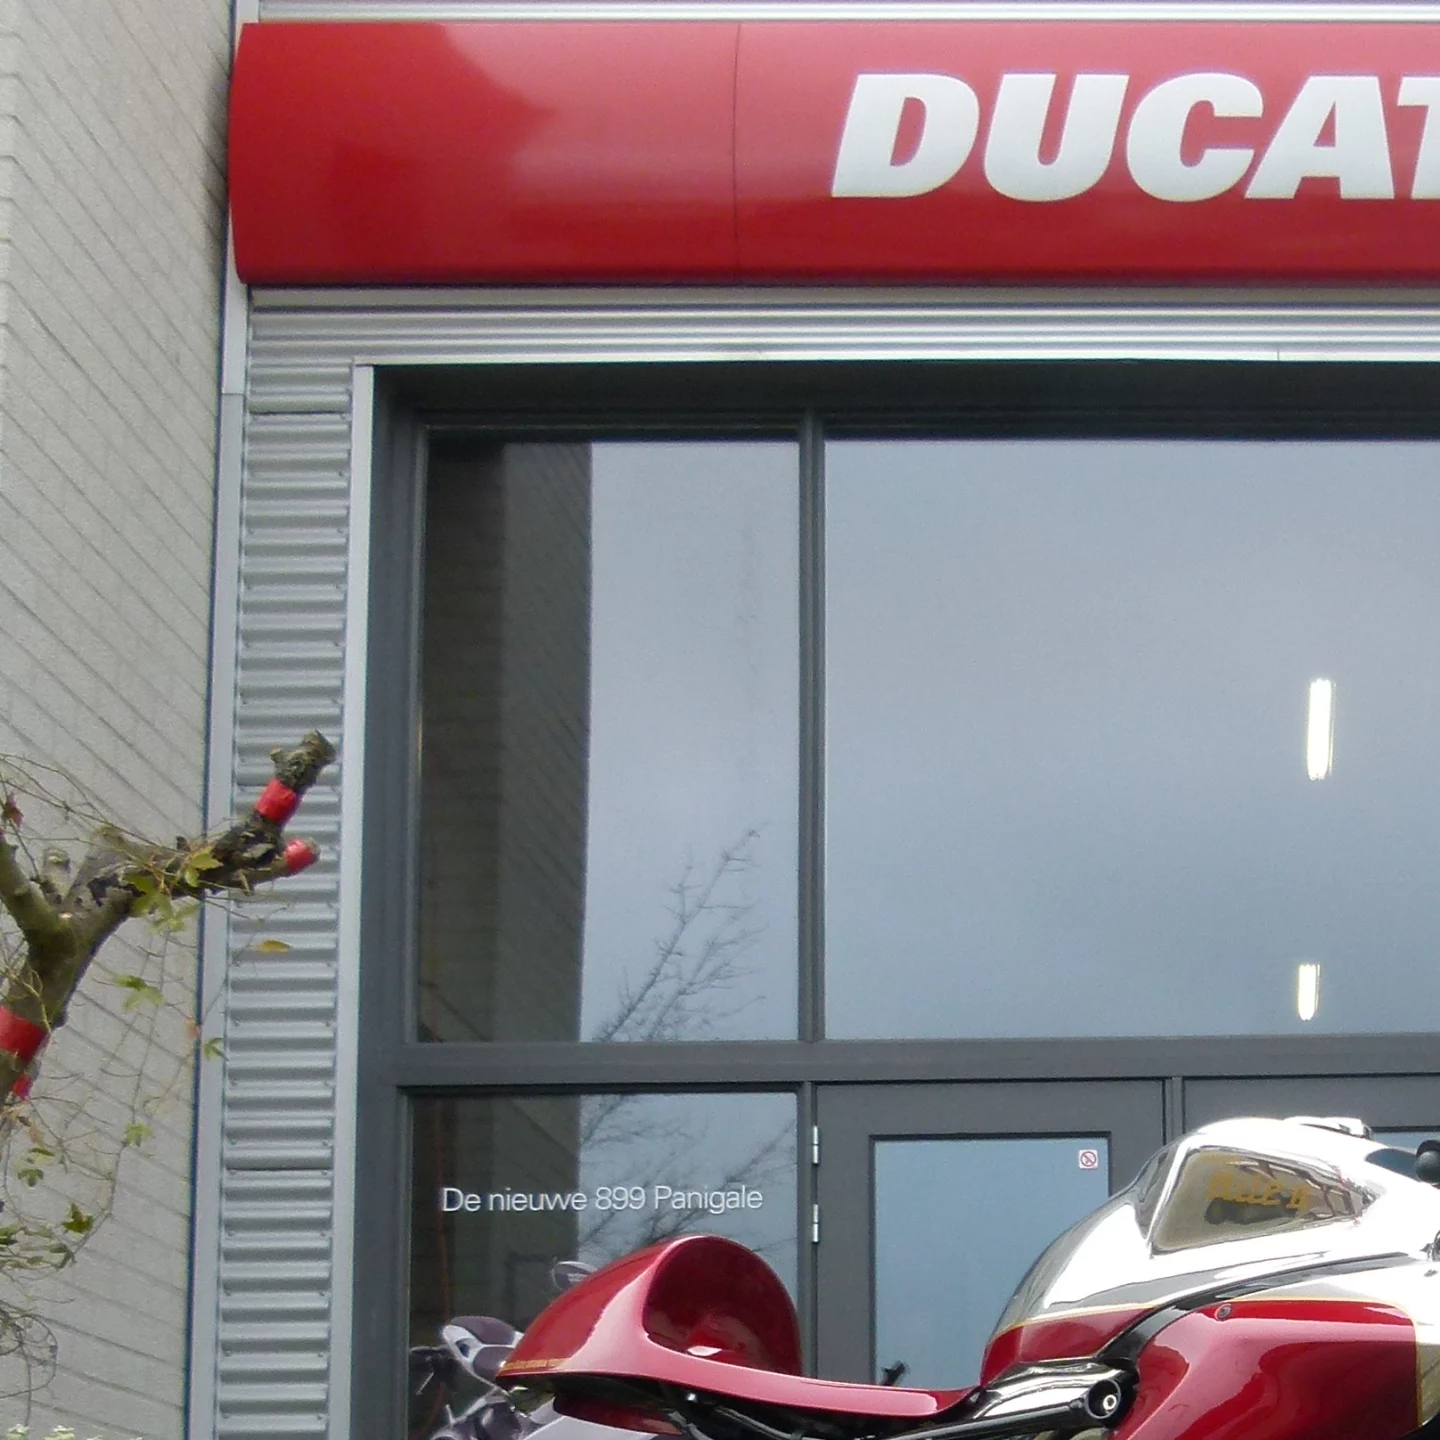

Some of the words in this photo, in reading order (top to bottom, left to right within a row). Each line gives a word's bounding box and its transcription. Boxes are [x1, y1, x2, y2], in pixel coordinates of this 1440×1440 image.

[442, 1187, 482, 1212] De
[488, 1187, 588, 1212] nieuwe
[595, 1186, 646, 1210] 899
[653, 1185, 764, 1215] Panigale
